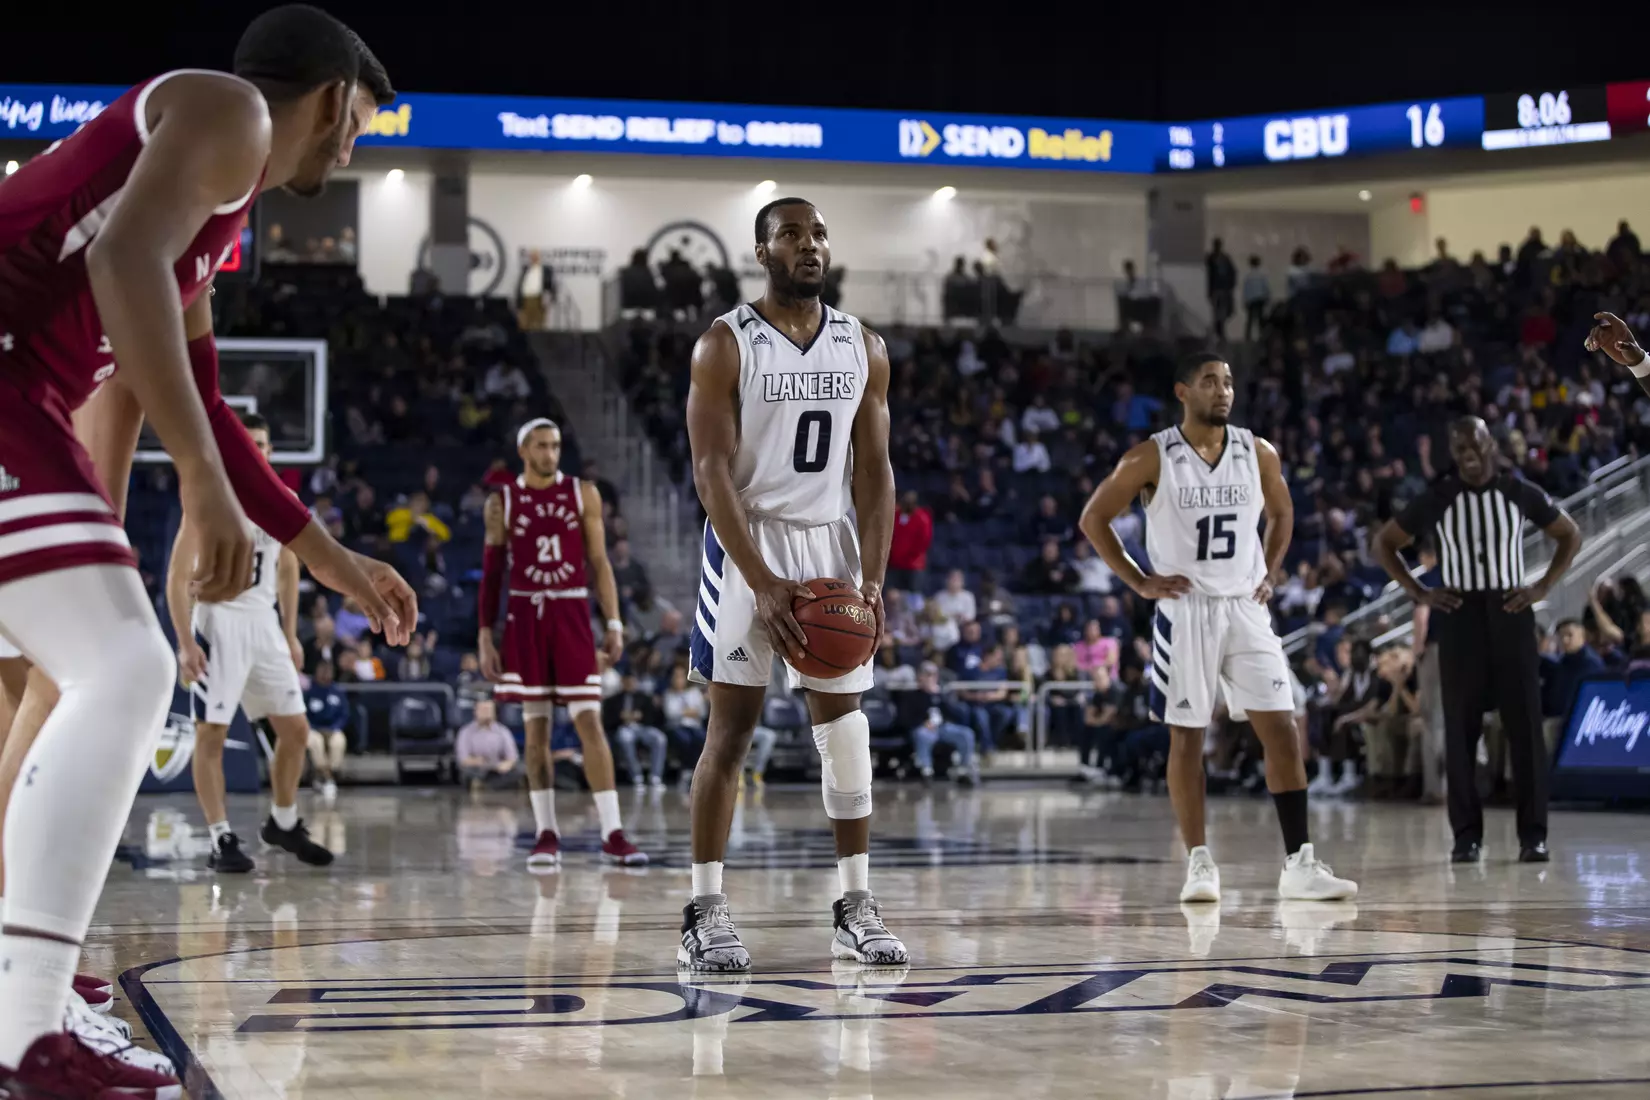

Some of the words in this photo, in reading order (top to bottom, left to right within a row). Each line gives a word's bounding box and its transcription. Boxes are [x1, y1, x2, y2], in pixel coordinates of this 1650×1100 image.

[551, 113, 625, 141] SEND
[625, 116, 716, 144] RELIEF
[1263, 114, 1349, 162] CBU
[1406, 103, 1445, 148] 16
[943, 123, 1025, 158] SEND
[1028, 128, 1113, 162] Relief
[832, 335, 852, 345] WAC
[763, 372, 855, 402] LANCERS
[793, 410, 832, 473] 0
[1180, 484, 1249, 509] LANCERS
[535, 502, 579, 531] STATE
[536, 534, 561, 563] 21
[1196, 513, 1237, 561] 15
